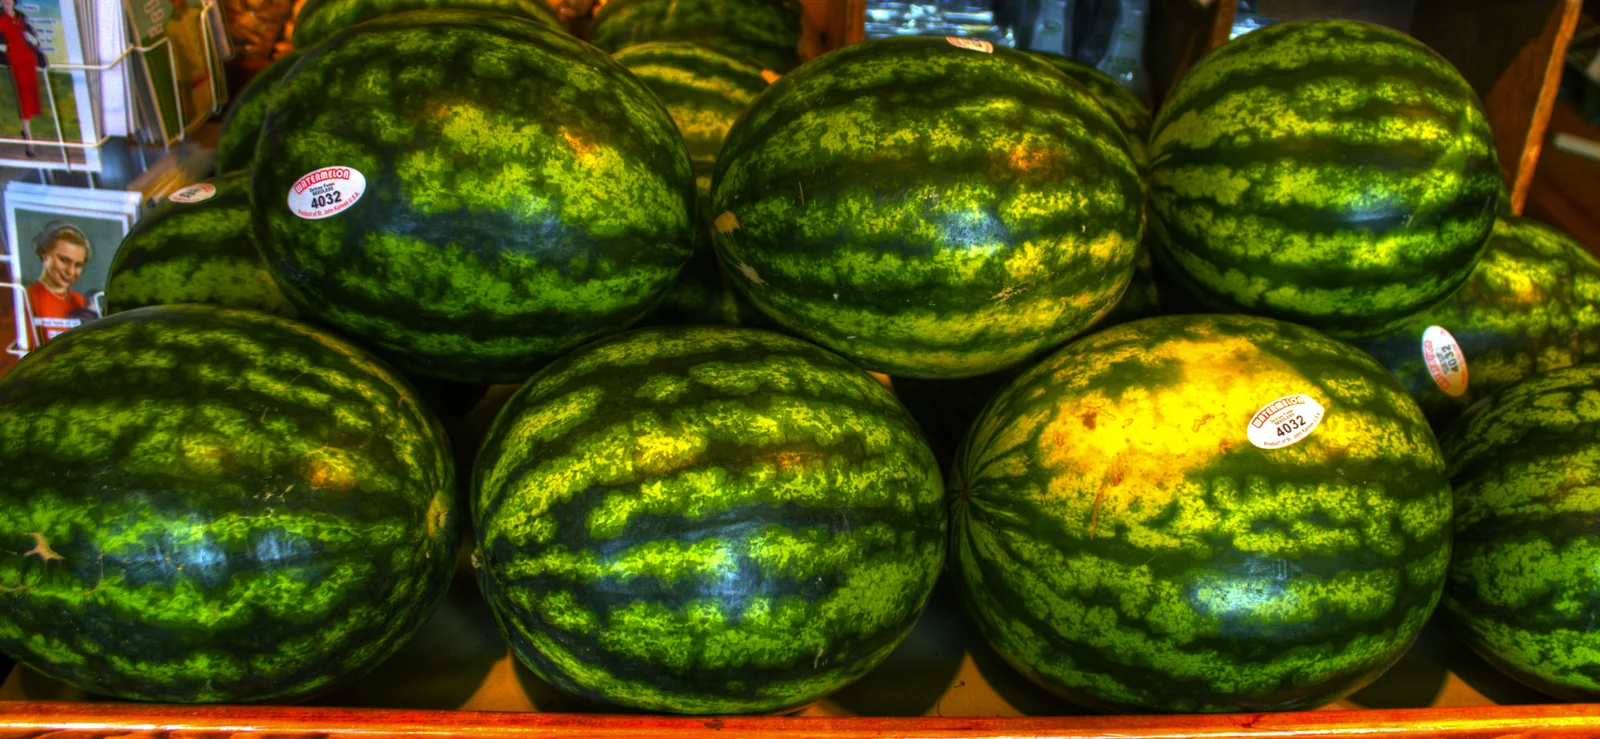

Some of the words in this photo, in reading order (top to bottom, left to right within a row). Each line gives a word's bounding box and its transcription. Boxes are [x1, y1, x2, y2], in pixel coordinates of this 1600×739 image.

[294, 168, 350, 194] WATERMELON
[311, 190, 342, 208] 4032
[312, 187, 334, 196] SEEDLESS
[298, 209, 312, 217] Product
[334, 202, 349, 212] Kansas
[1252, 396, 1305, 428] WATERMELON
[1276, 415, 1306, 437] 4032
